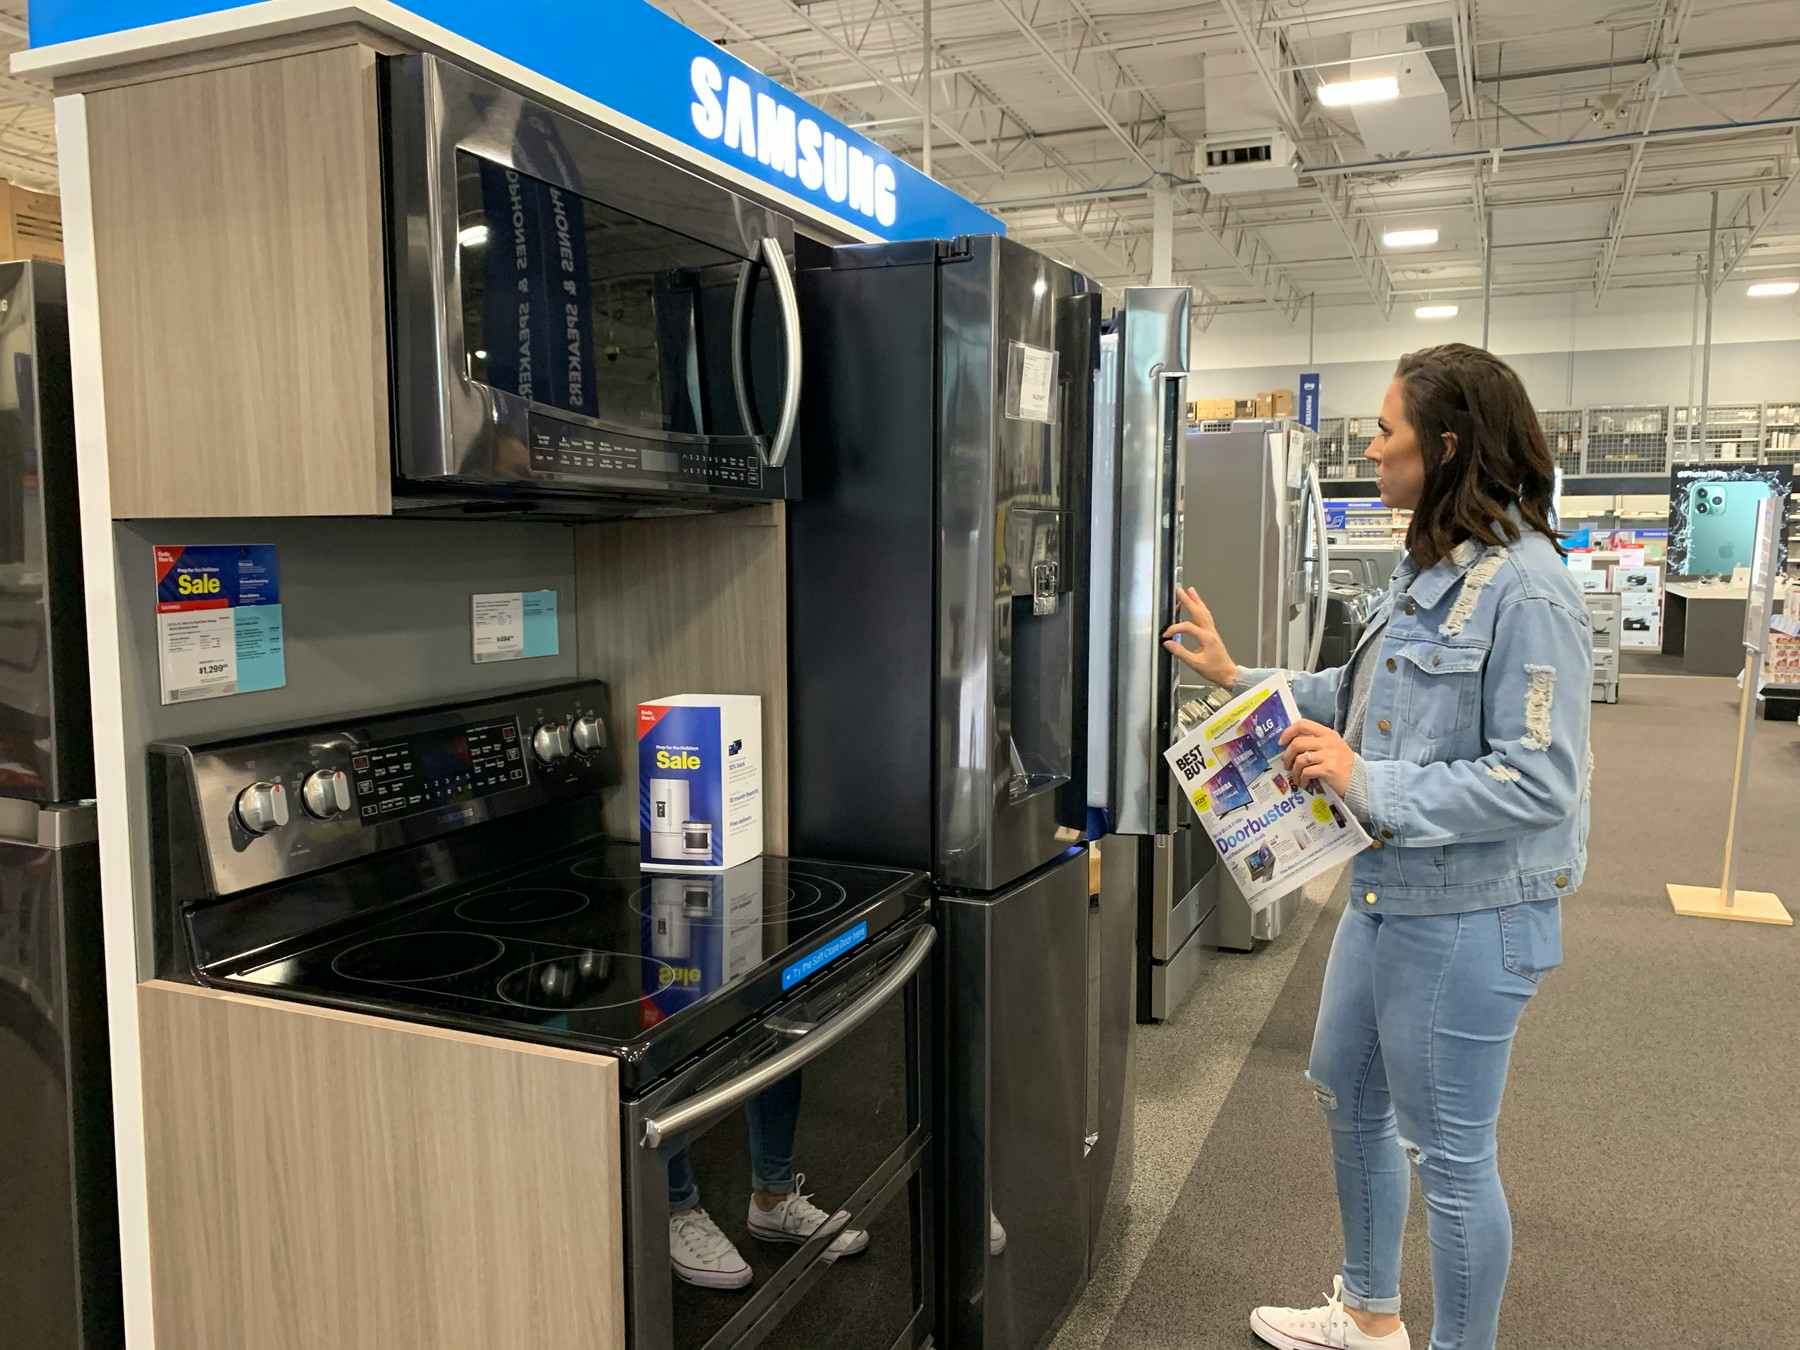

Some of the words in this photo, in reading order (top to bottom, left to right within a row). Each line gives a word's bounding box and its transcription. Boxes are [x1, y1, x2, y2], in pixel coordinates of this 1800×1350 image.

[690, 56, 896, 227] SAMSUNG
[178, 573, 220, 595] Sale
[1262, 719, 1274, 732] LG
[656, 750, 701, 770] Sale
[1176, 744, 1202, 771] BEST
[1184, 757, 1207, 781] BUY
[1215, 791, 1305, 855] Doorbusters
